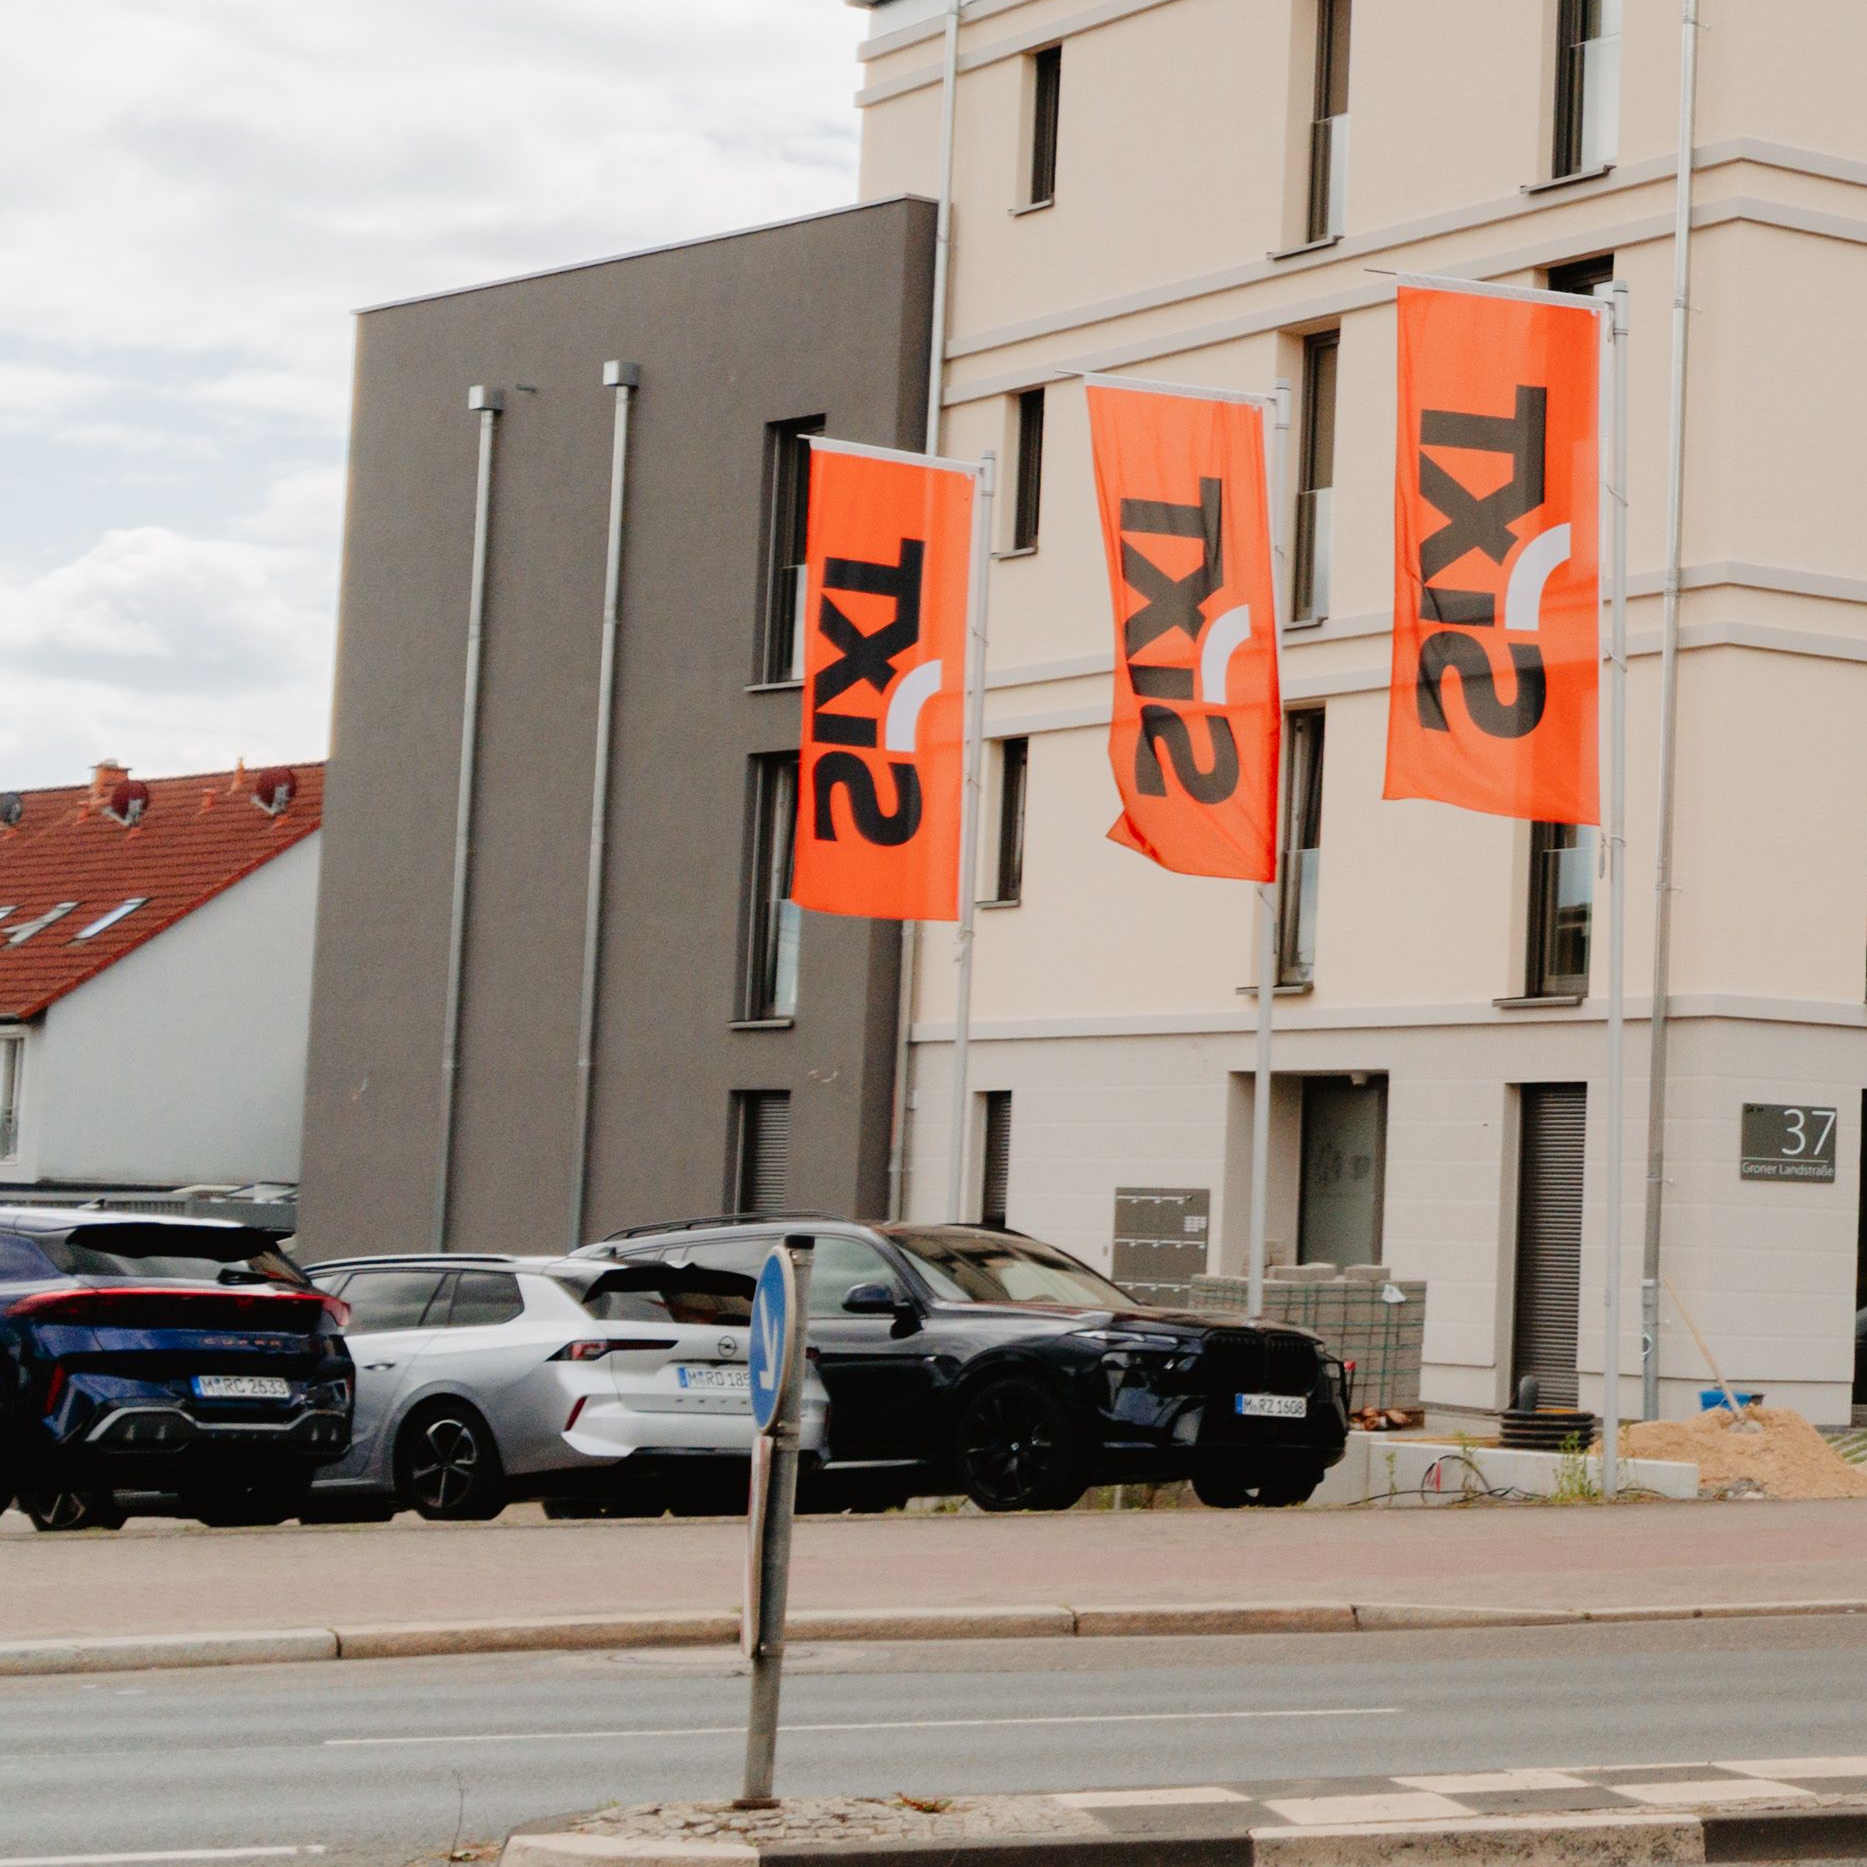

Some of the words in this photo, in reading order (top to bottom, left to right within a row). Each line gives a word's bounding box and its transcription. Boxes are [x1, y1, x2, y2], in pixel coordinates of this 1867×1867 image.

[1781, 1108, 1836, 1155] 37
[1742, 1162, 1777, 1175] Groner
[1779, 1164, 1834, 1177] Landstraße
[687, 1371, 697, 1385] M
[202, 1378, 214, 1394] M
[223, 1378, 246, 1394] RC
[250, 1378, 287, 1395] 2633
